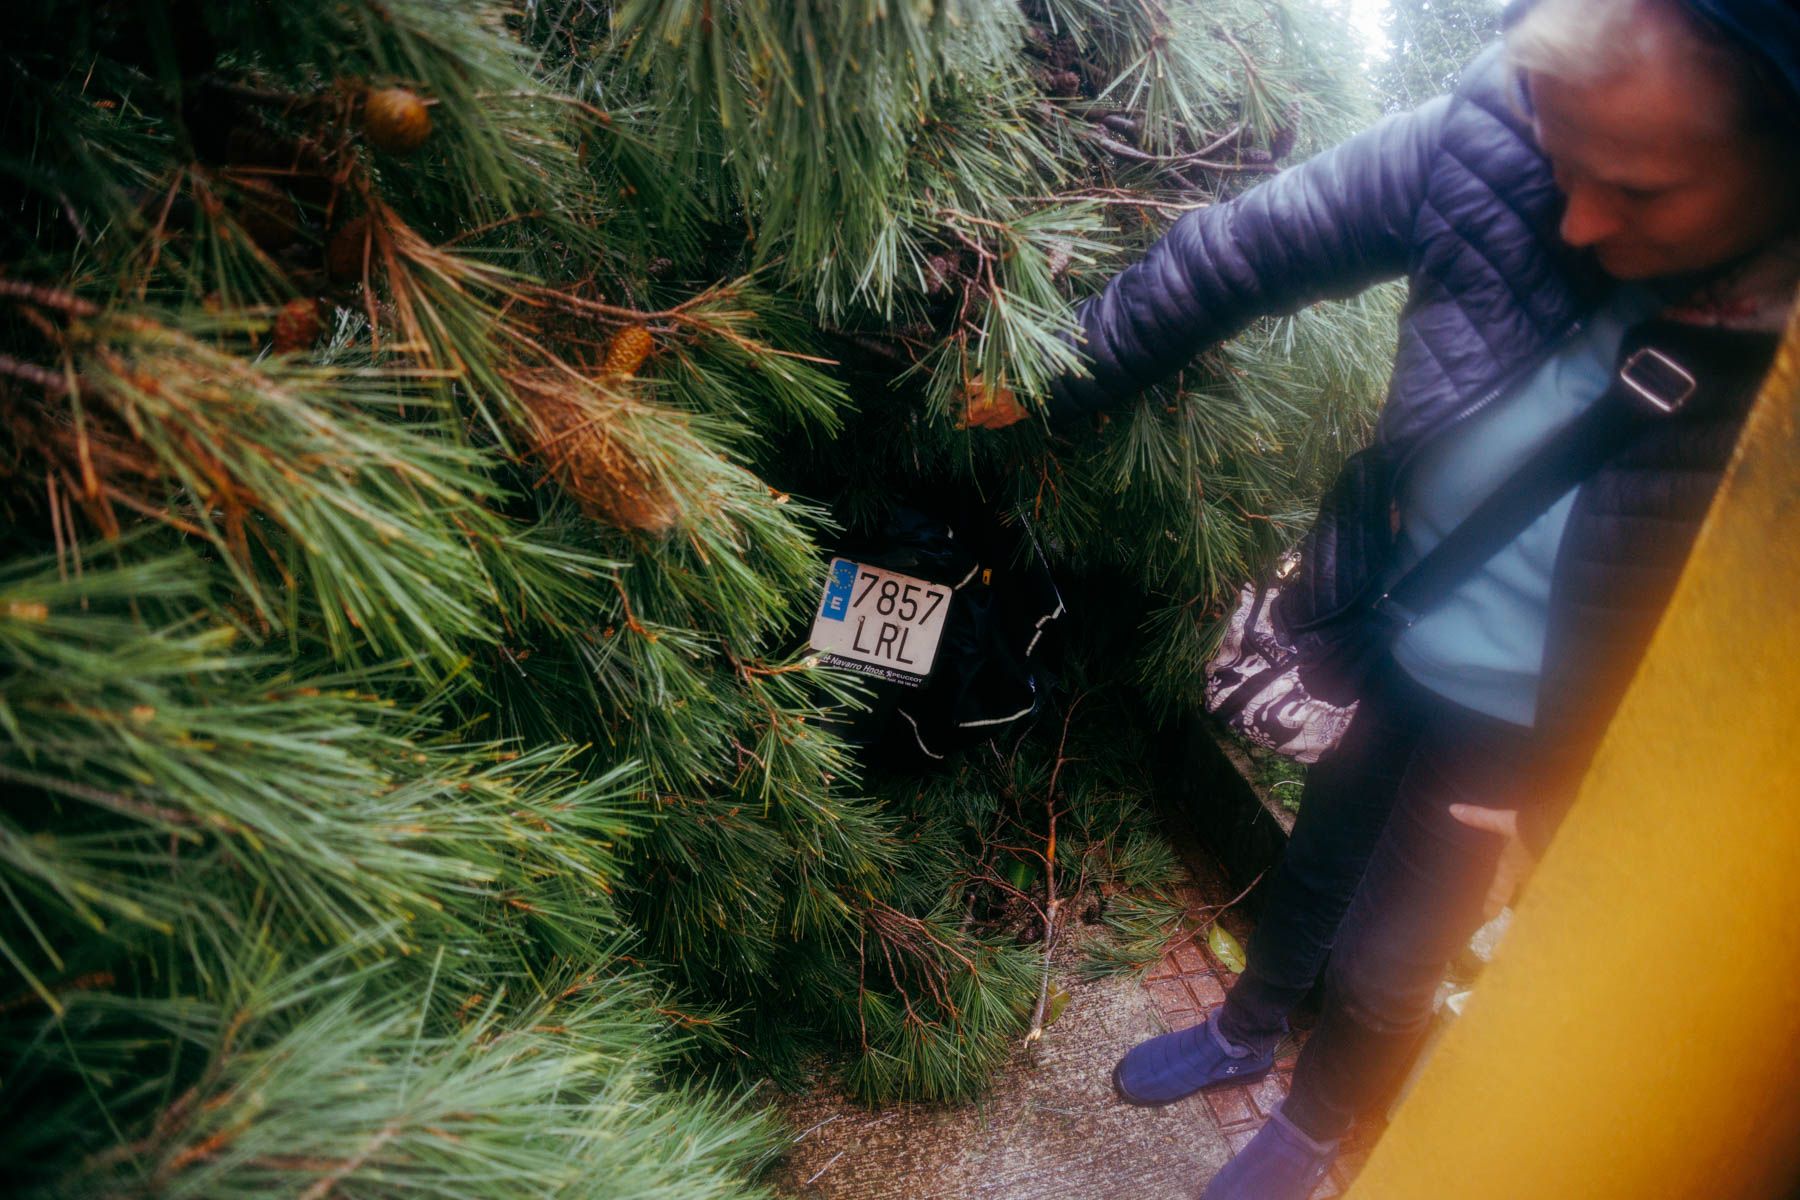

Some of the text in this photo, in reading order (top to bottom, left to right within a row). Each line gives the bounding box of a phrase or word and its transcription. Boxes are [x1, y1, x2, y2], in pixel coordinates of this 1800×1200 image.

[830, 596, 843, 611] E
[853, 572, 944, 626] 7857
[852, 615, 914, 665] LRL
[830, 656, 863, 670] Navarro
[862, 664, 885, 676] Hnos.
[892, 672, 922, 683] PEUGEOT
